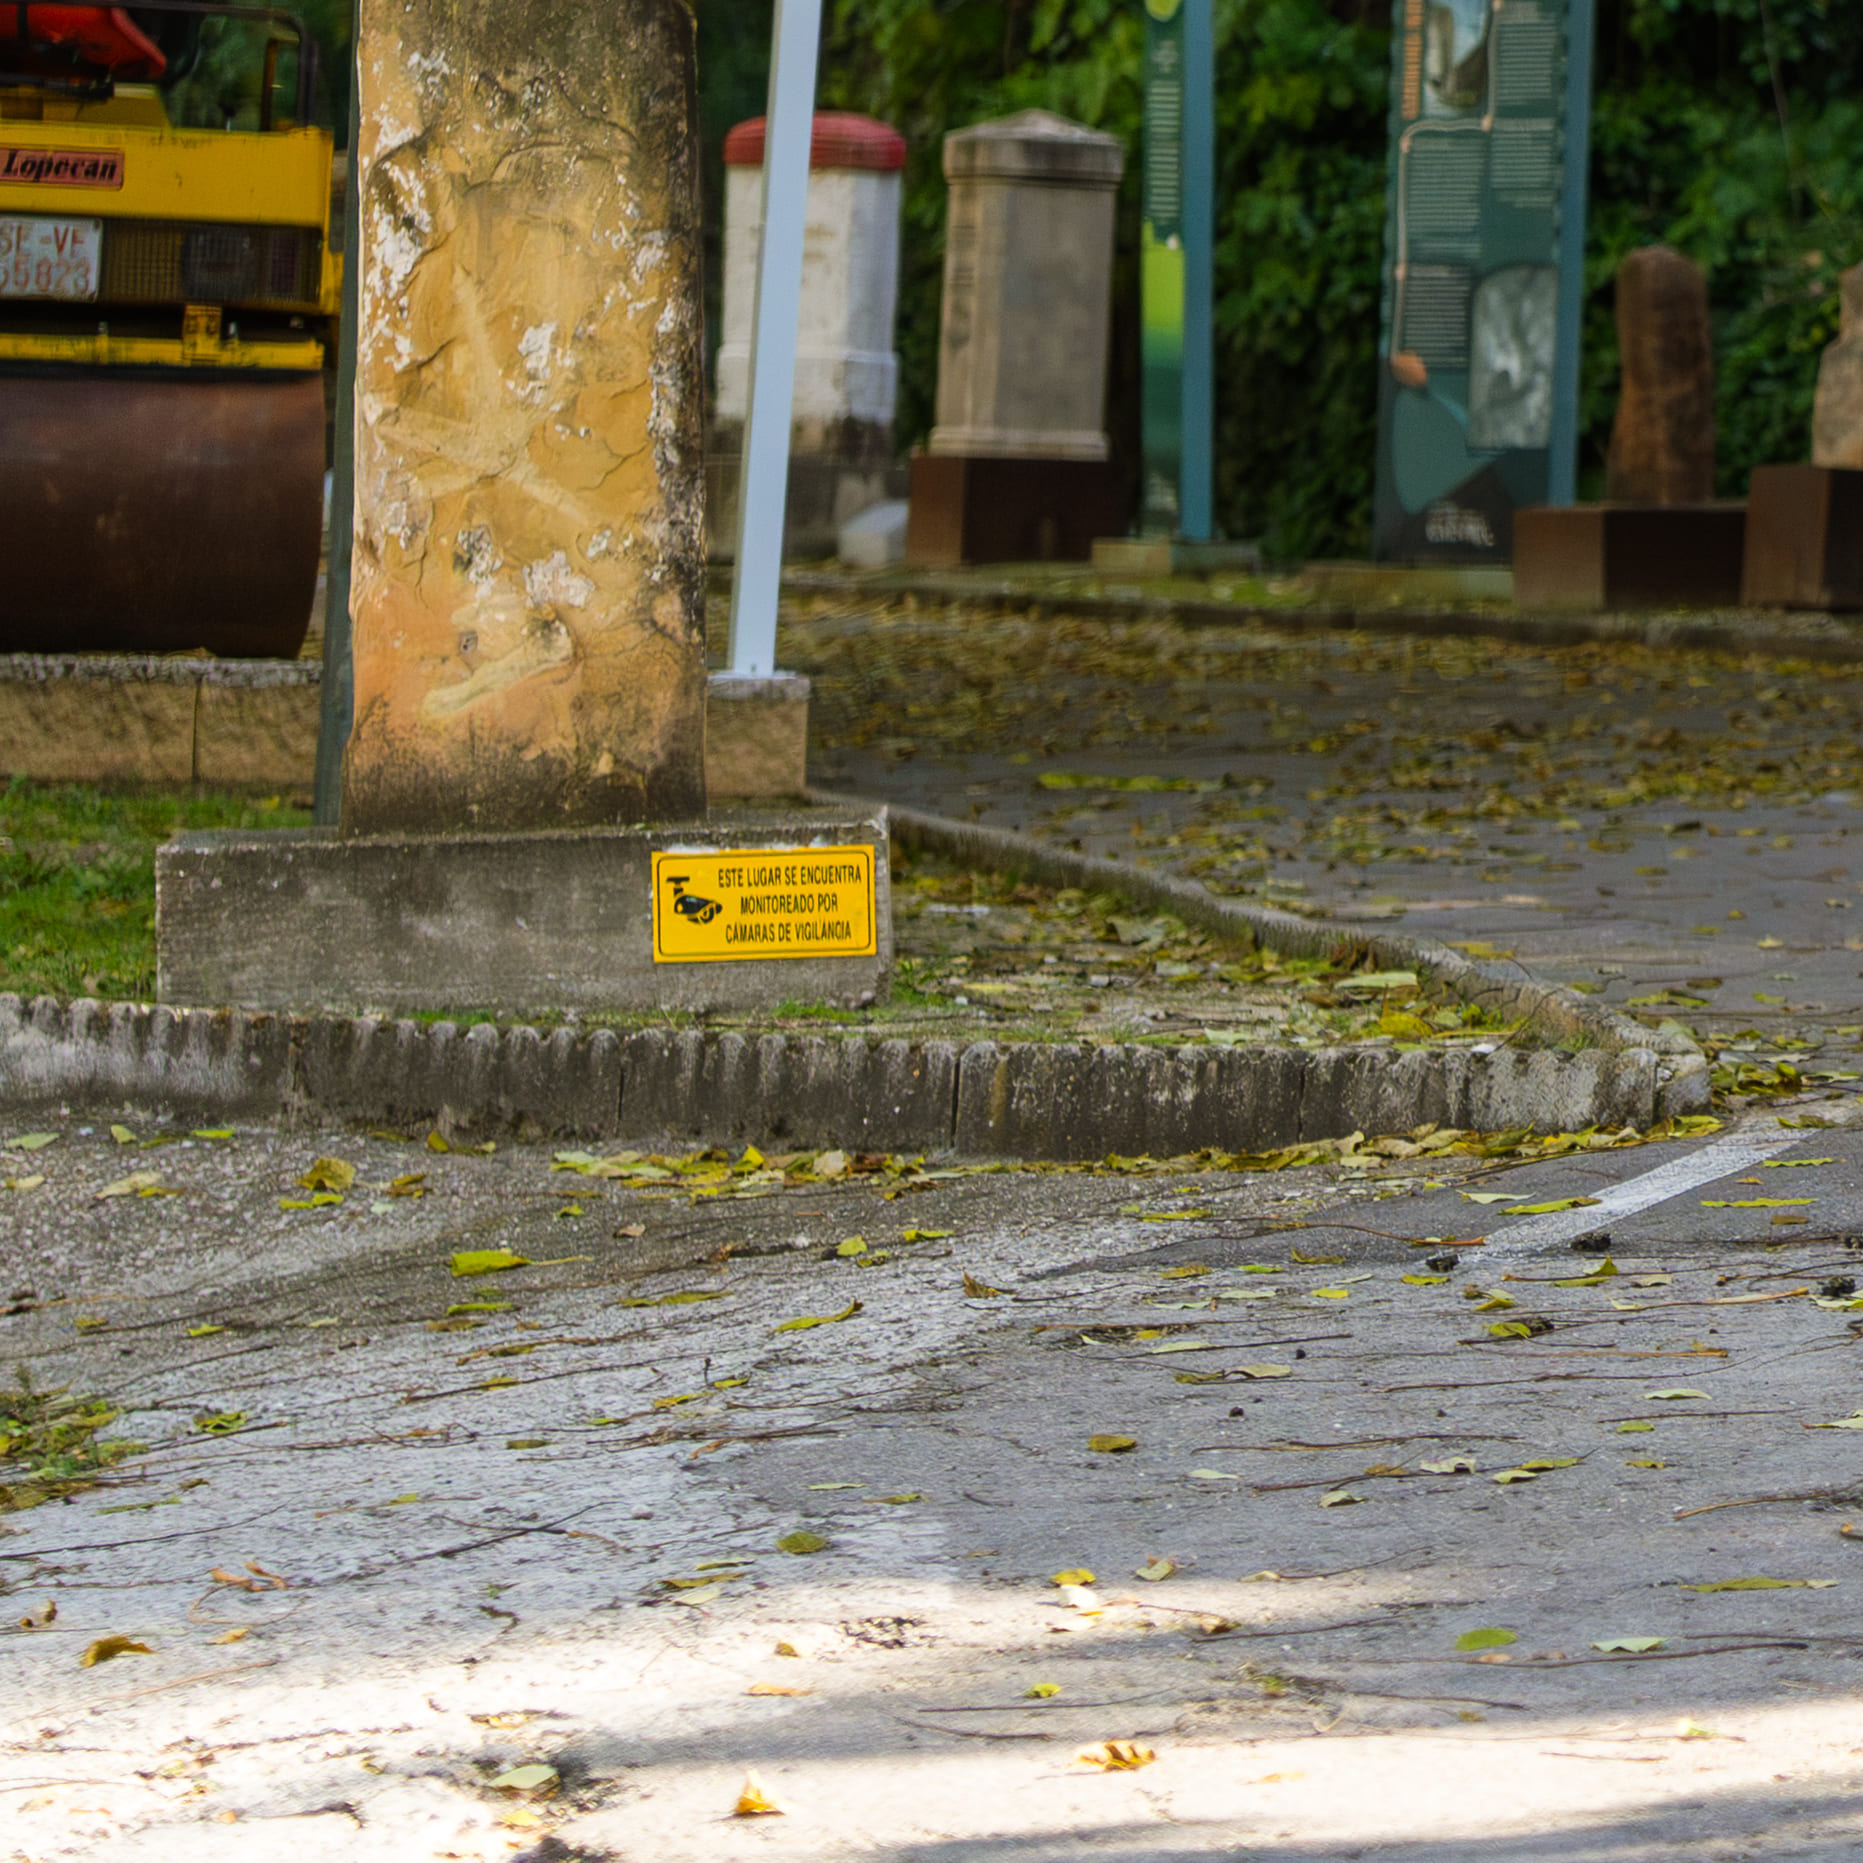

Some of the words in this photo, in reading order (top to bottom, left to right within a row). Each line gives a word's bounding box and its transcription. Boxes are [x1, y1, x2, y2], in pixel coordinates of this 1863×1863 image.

[718, 868, 744, 888] ESTE
[747, 867, 781, 887] LUGAR
[784, 866, 797, 885] SE
[801, 864, 861, 884] ENCUENTRA
[740, 894, 815, 914] MONITOREADO
[818, 893, 838, 912] POR
[725, 921, 775, 944] CÁMARAS
[778, 923, 791, 942] DE
